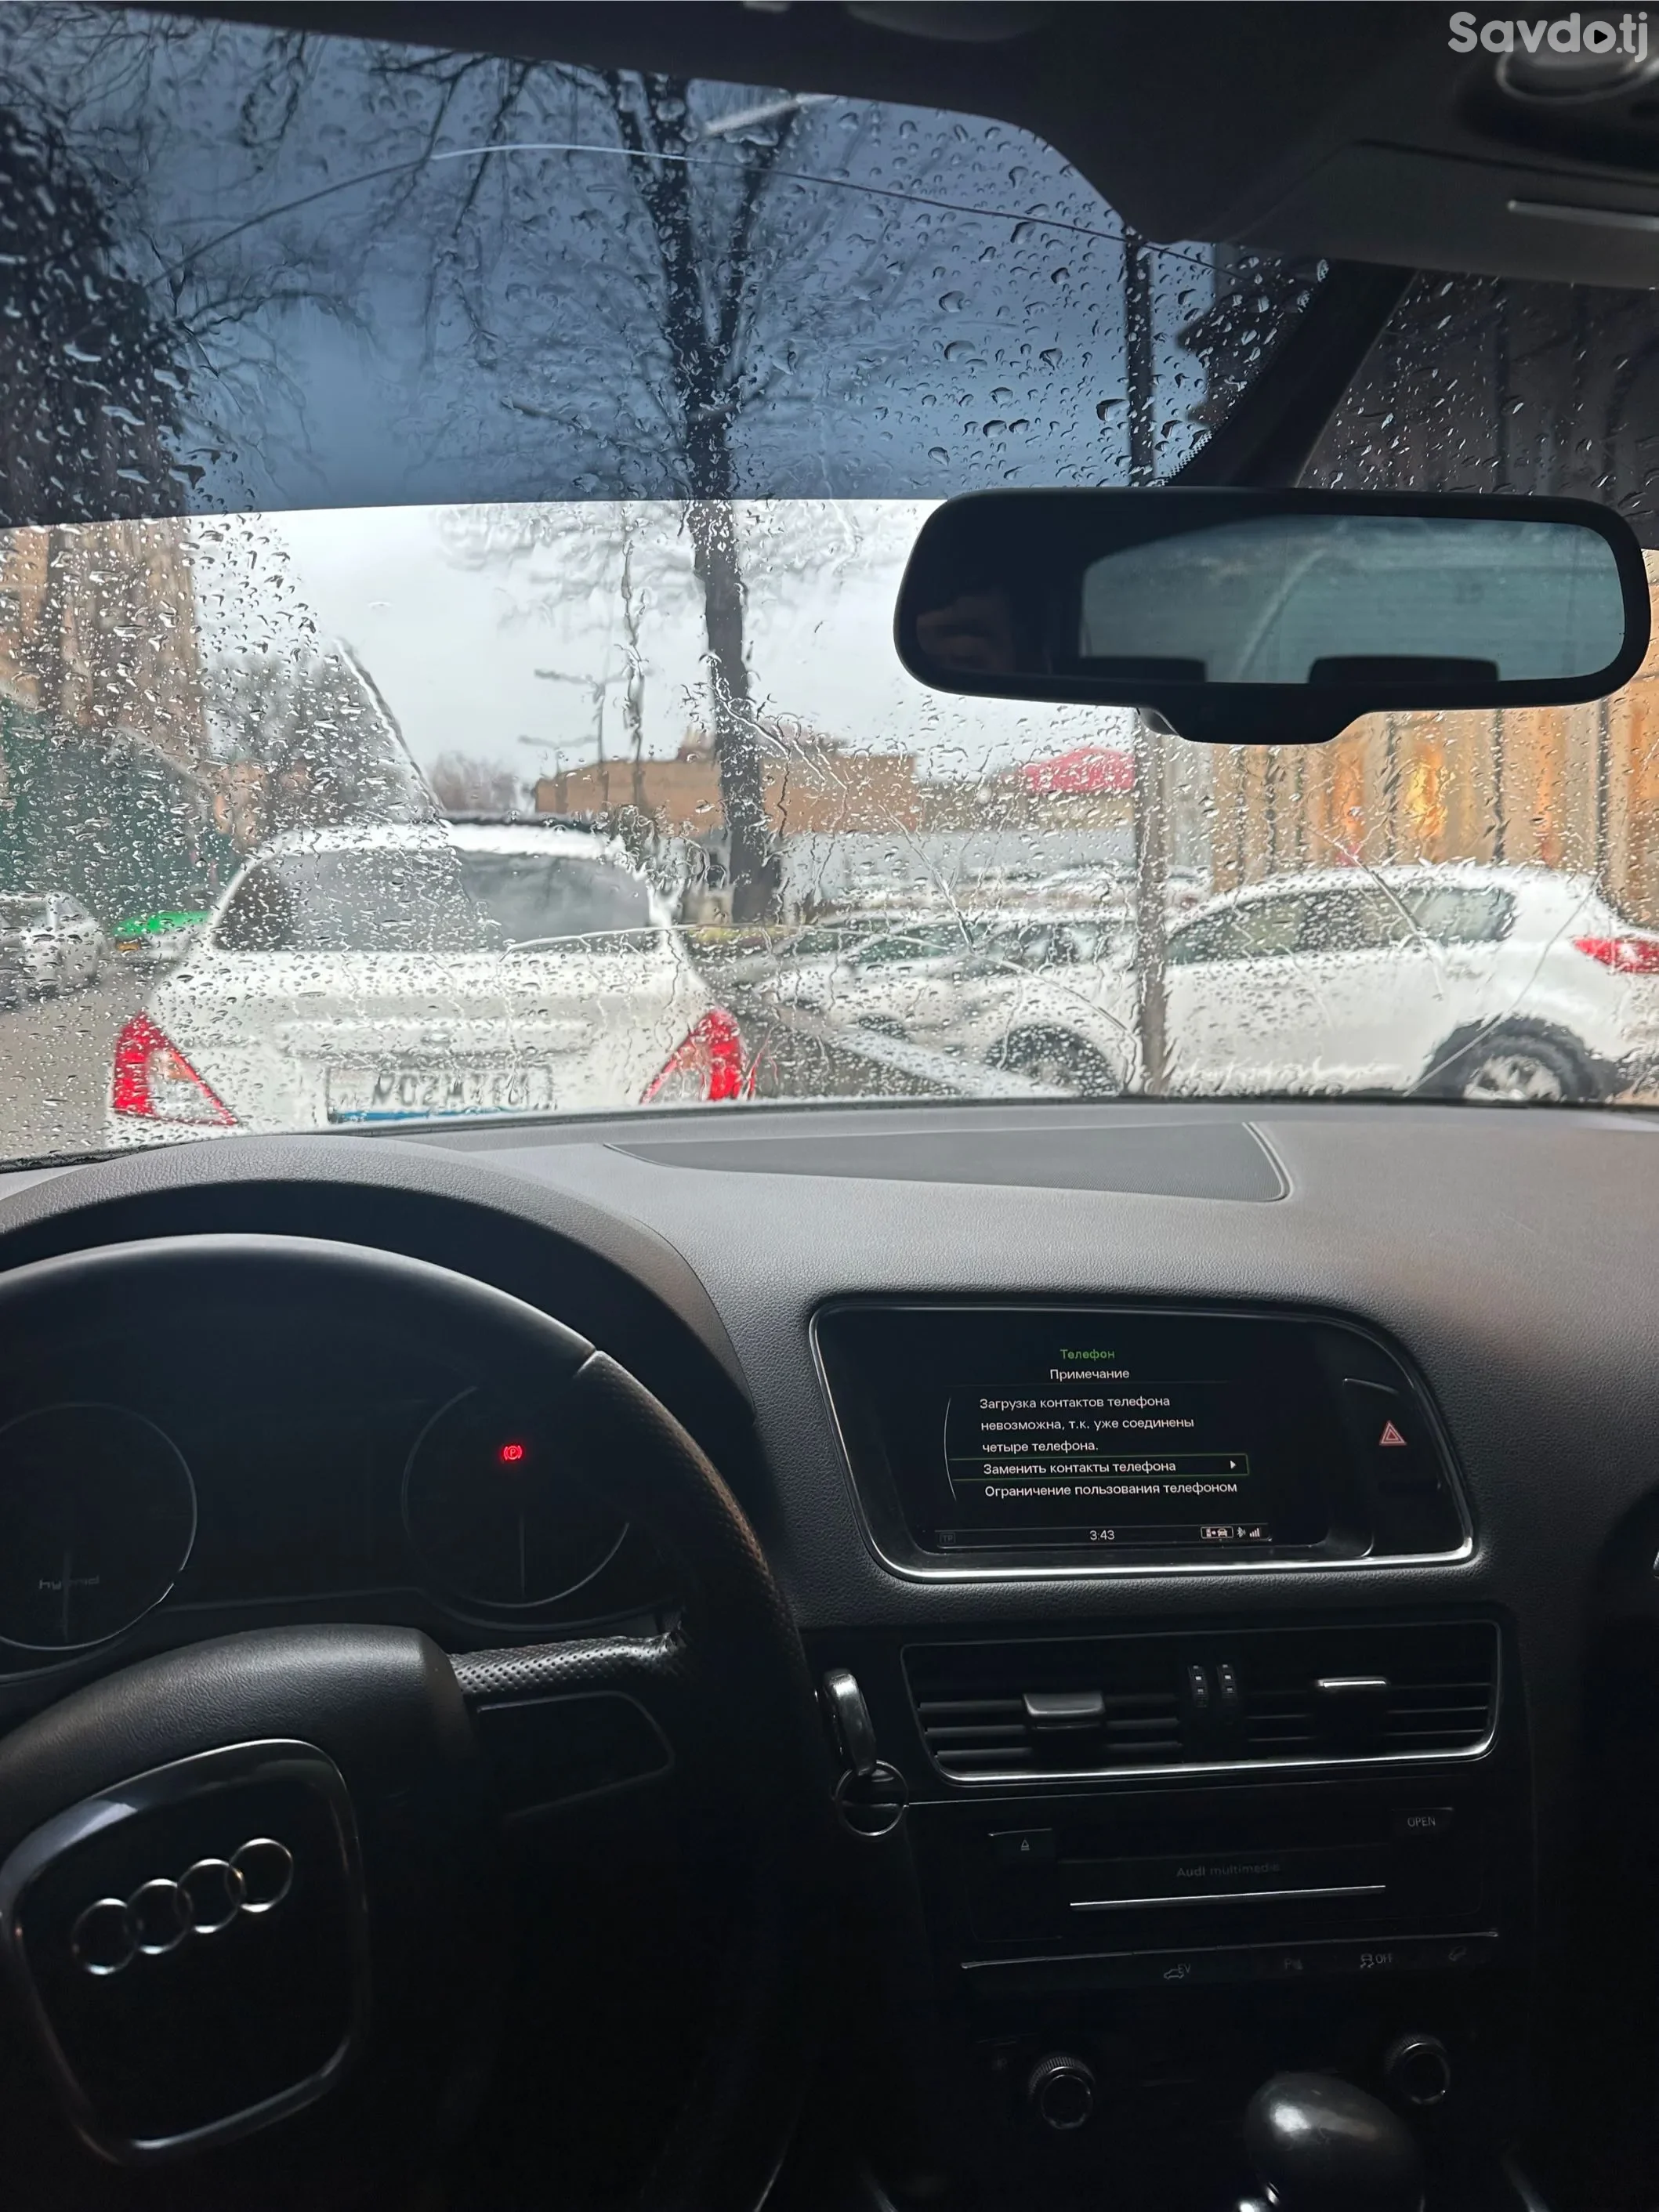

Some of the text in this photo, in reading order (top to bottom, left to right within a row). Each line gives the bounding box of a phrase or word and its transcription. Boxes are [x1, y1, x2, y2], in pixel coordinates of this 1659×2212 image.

[1060, 1349, 1115, 1361] Телефон
[1049, 1368, 1130, 1382] Примечание
[980, 1396, 1171, 1411] Загрузка контактов телефона
[980, 1418, 1194, 1432] невозможна, т.к. уже соединены
[982, 1440, 1099, 1455] четыре телефона.
[983, 1461, 1176, 1475] Заменить контакты телефона
[984, 1482, 1237, 1498] Ограничение пользования телефоном
[1089, 1530, 1115, 1541] 3:43
[1407, 1816, 1436, 1827] OPEN
[1176, 1865, 1206, 1877] Audi
[1375, 1952, 1394, 1964] OFF
